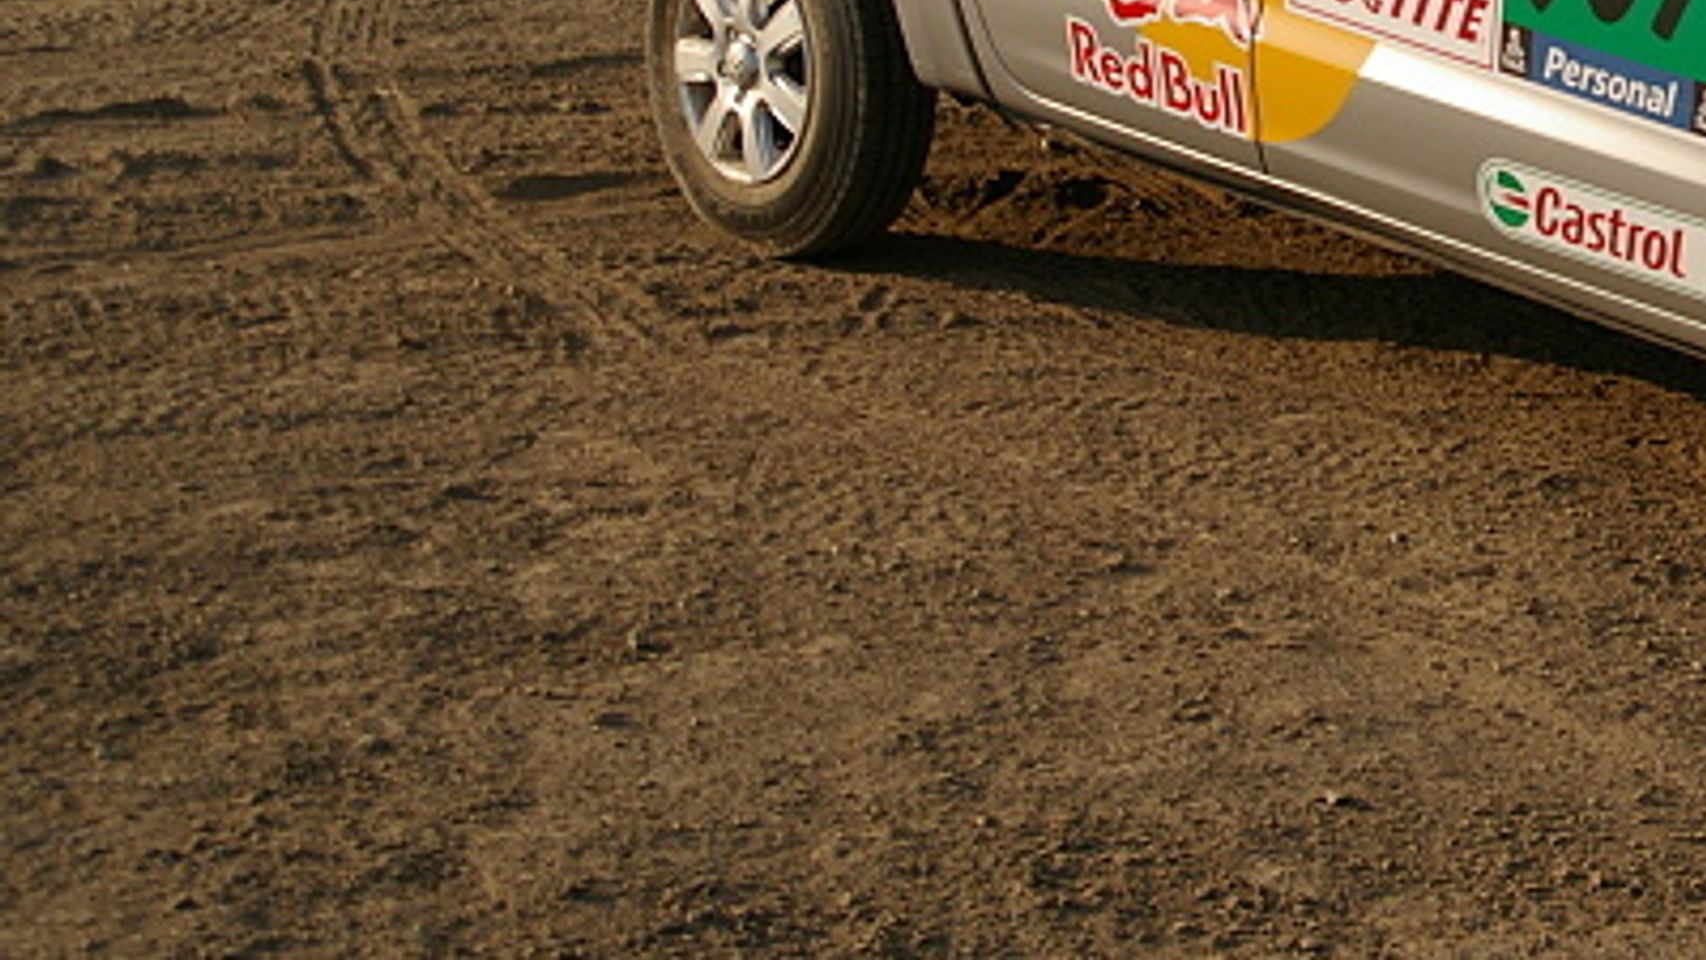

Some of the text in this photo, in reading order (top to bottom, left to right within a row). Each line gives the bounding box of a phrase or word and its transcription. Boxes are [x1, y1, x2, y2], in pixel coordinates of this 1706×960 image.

[1067, 17, 1248, 133] Red Bull
[1543, 45, 1680, 119] Personal
[1535, 186, 1687, 279] Castrol
